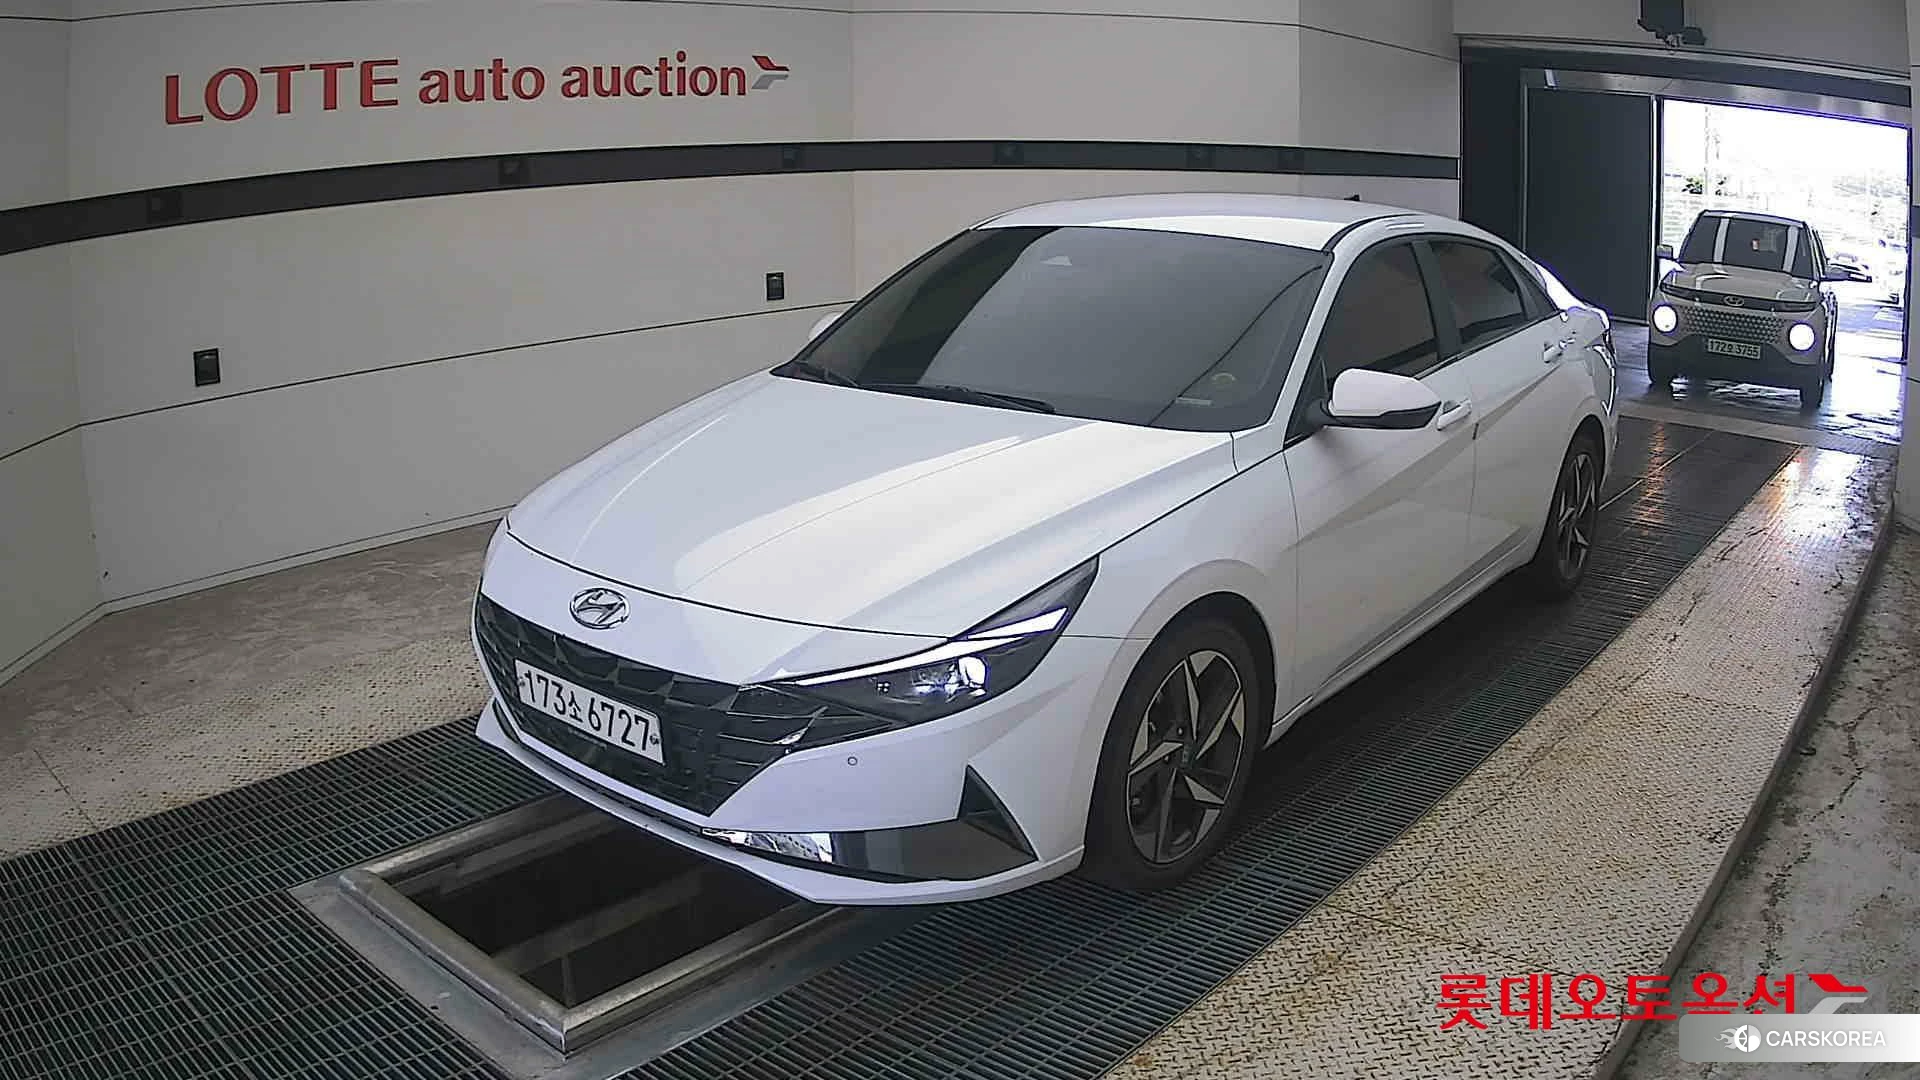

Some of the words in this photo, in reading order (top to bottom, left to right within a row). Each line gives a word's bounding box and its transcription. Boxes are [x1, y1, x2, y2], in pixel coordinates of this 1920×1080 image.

[165, 58, 399, 125] LOTTE
[417, 57, 546, 104] auto
[560, 50, 747, 99] auction
[524, 669, 583, 723] 173소
[587, 697, 650, 751] 6727
